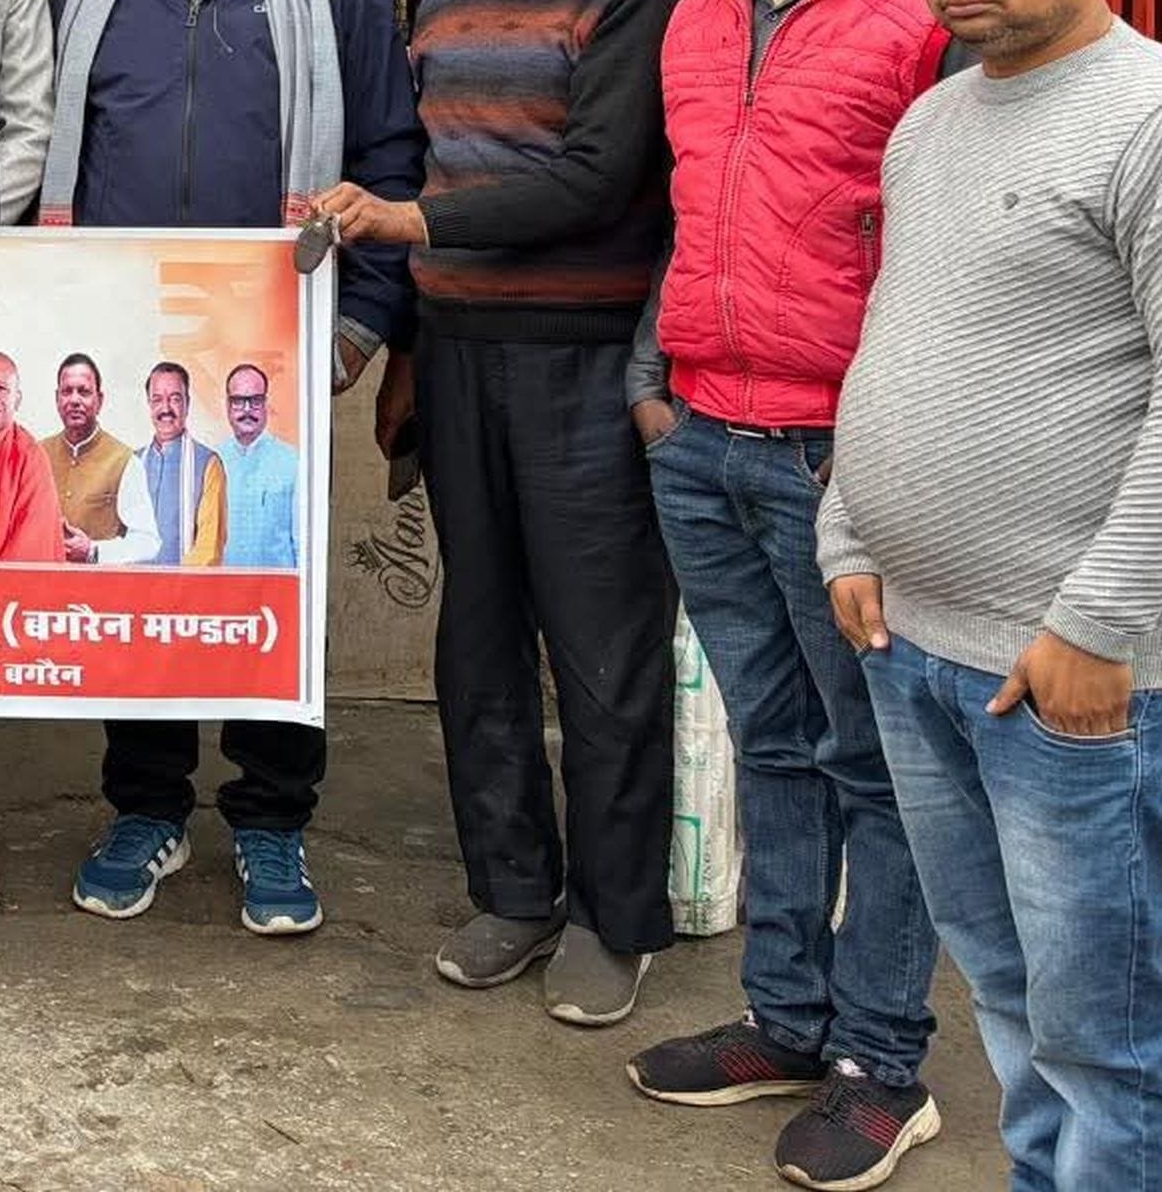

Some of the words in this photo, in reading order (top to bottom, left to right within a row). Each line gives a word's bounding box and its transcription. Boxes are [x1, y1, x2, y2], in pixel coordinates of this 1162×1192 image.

[2, 600, 135, 649] (बगरैन
[141, 605, 279, 654] मण्डल)
[5, 658, 84, 688] बगरैन
